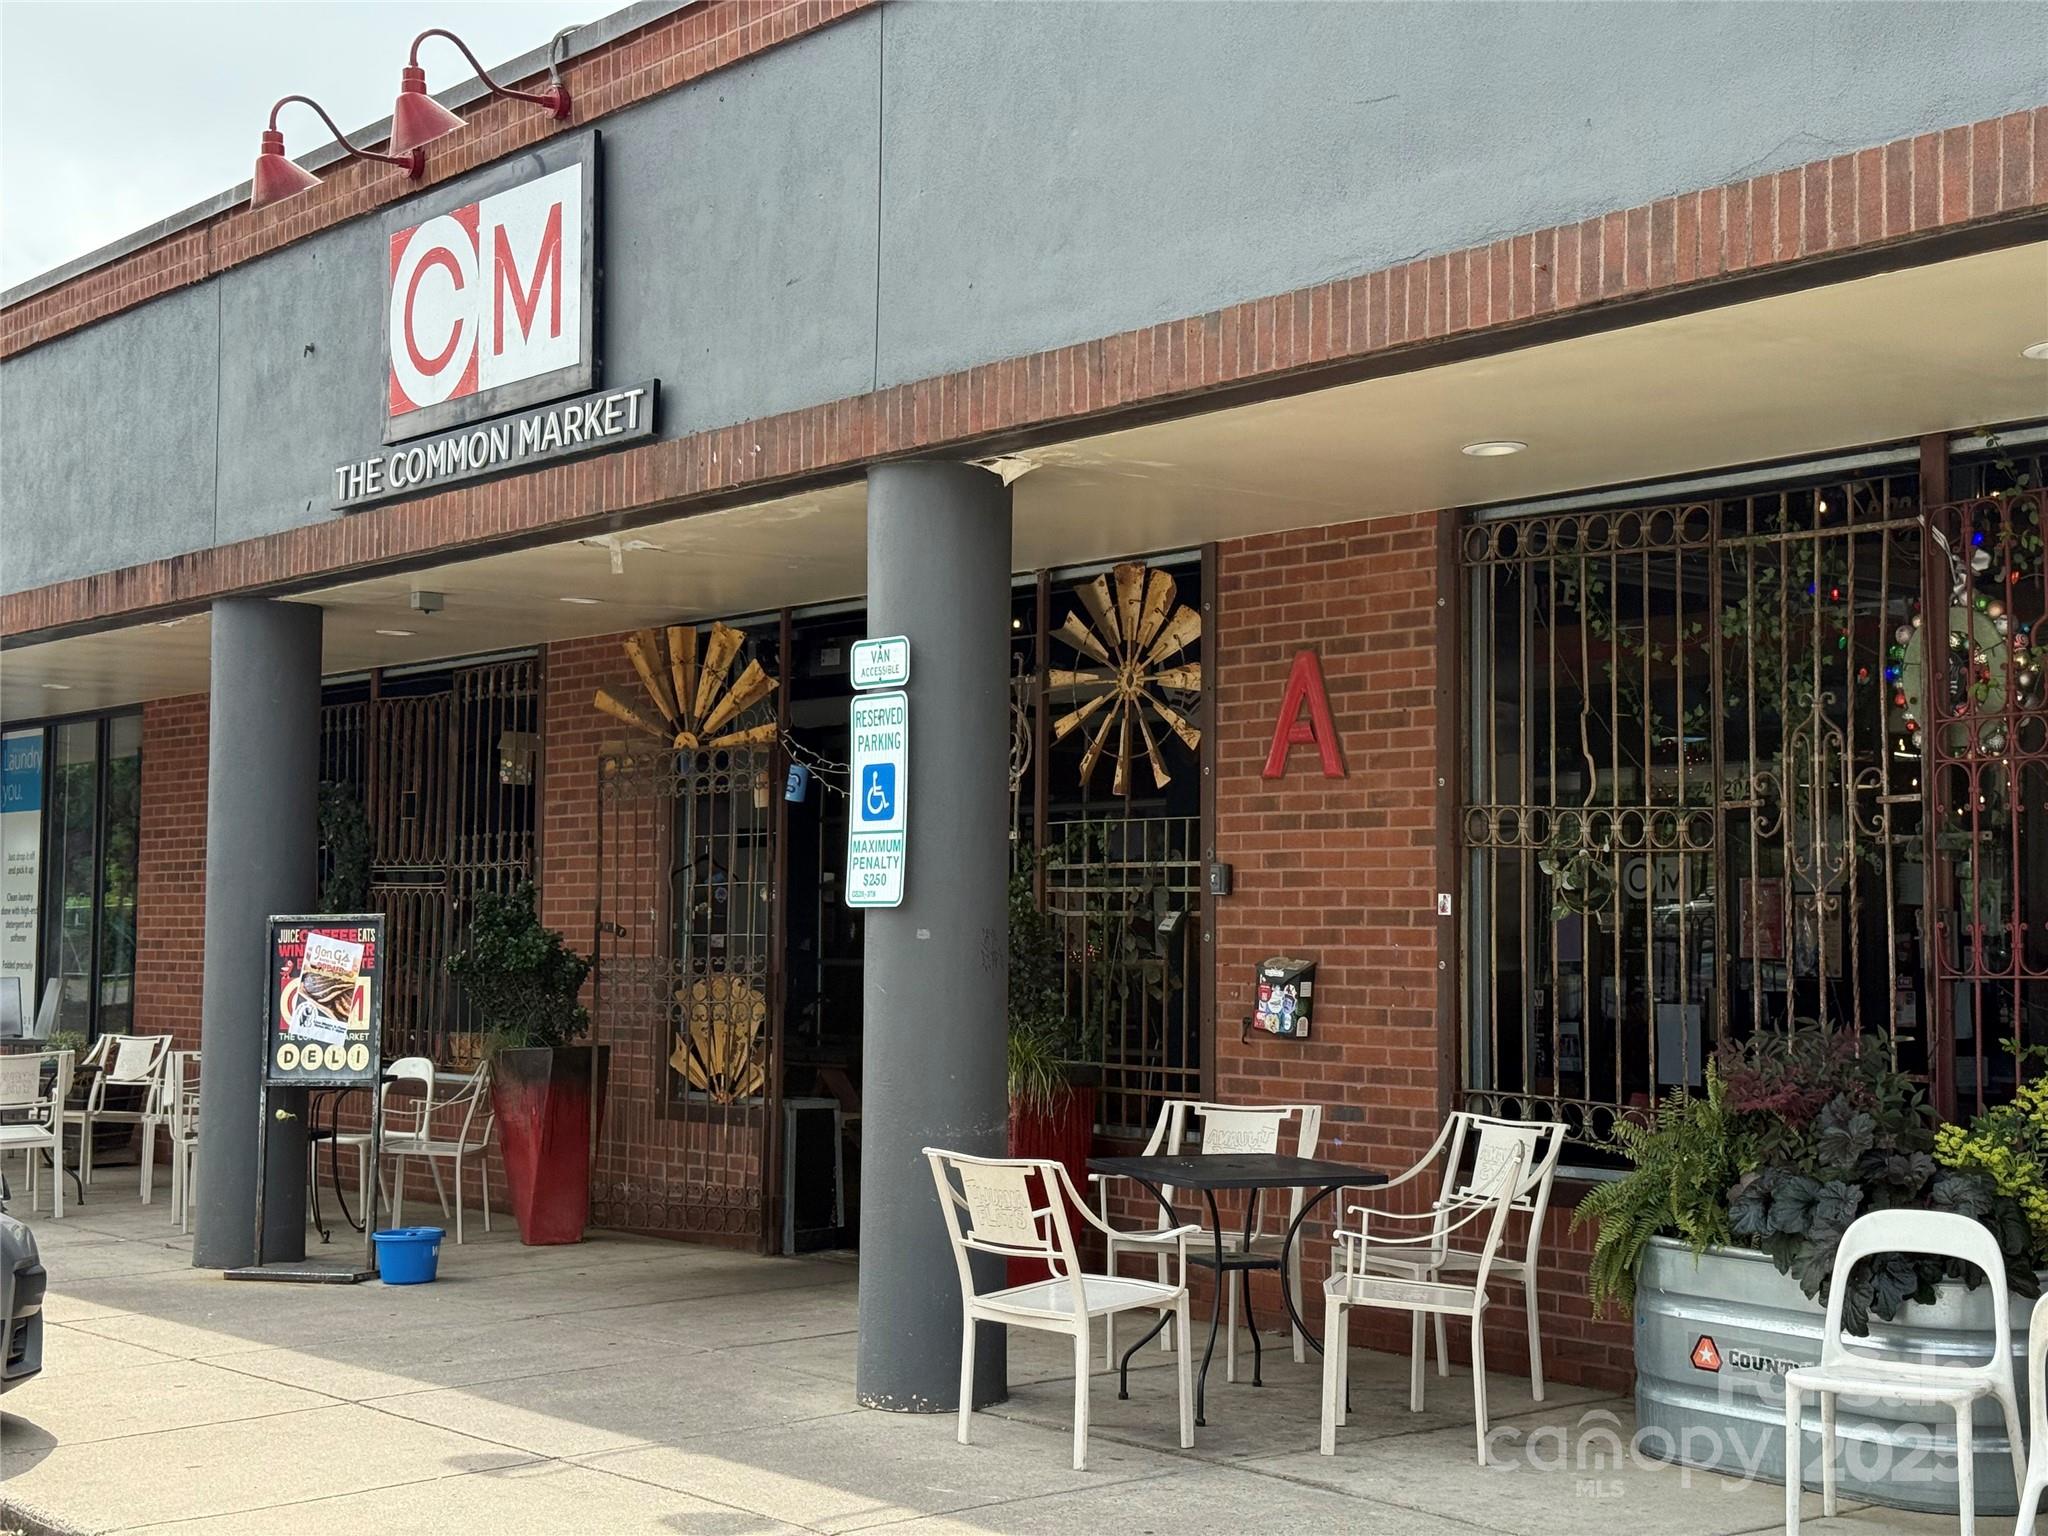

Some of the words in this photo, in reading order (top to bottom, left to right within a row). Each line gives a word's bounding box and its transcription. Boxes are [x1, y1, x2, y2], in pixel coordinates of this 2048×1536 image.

[404, 202, 562, 376] CM
[335, 457, 383, 500] THE
[389, 422, 511, 488] COMMON
[518, 388, 645, 456] MARKET
[871, 648, 890, 664] VAN
[860, 664, 900, 678] ACCESSIBLE
[855, 706, 903, 728] RESERVED
[1262, 650, 1345, 780] A
[858, 731, 901, 753] PARKING
[3, 745, 43, 776] Laundry
[852, 839, 901, 853] MAXIMUM
[852, 855, 900, 870] PENALTY
[863, 873, 887, 887] $250
[278, 928, 300, 944] JUICE
[357, 928, 376, 942] EATS
[278, 943, 305, 957] WIN
[343, 1032, 370, 1041] ARKET
[284, 1048, 361, 1064] DELI
